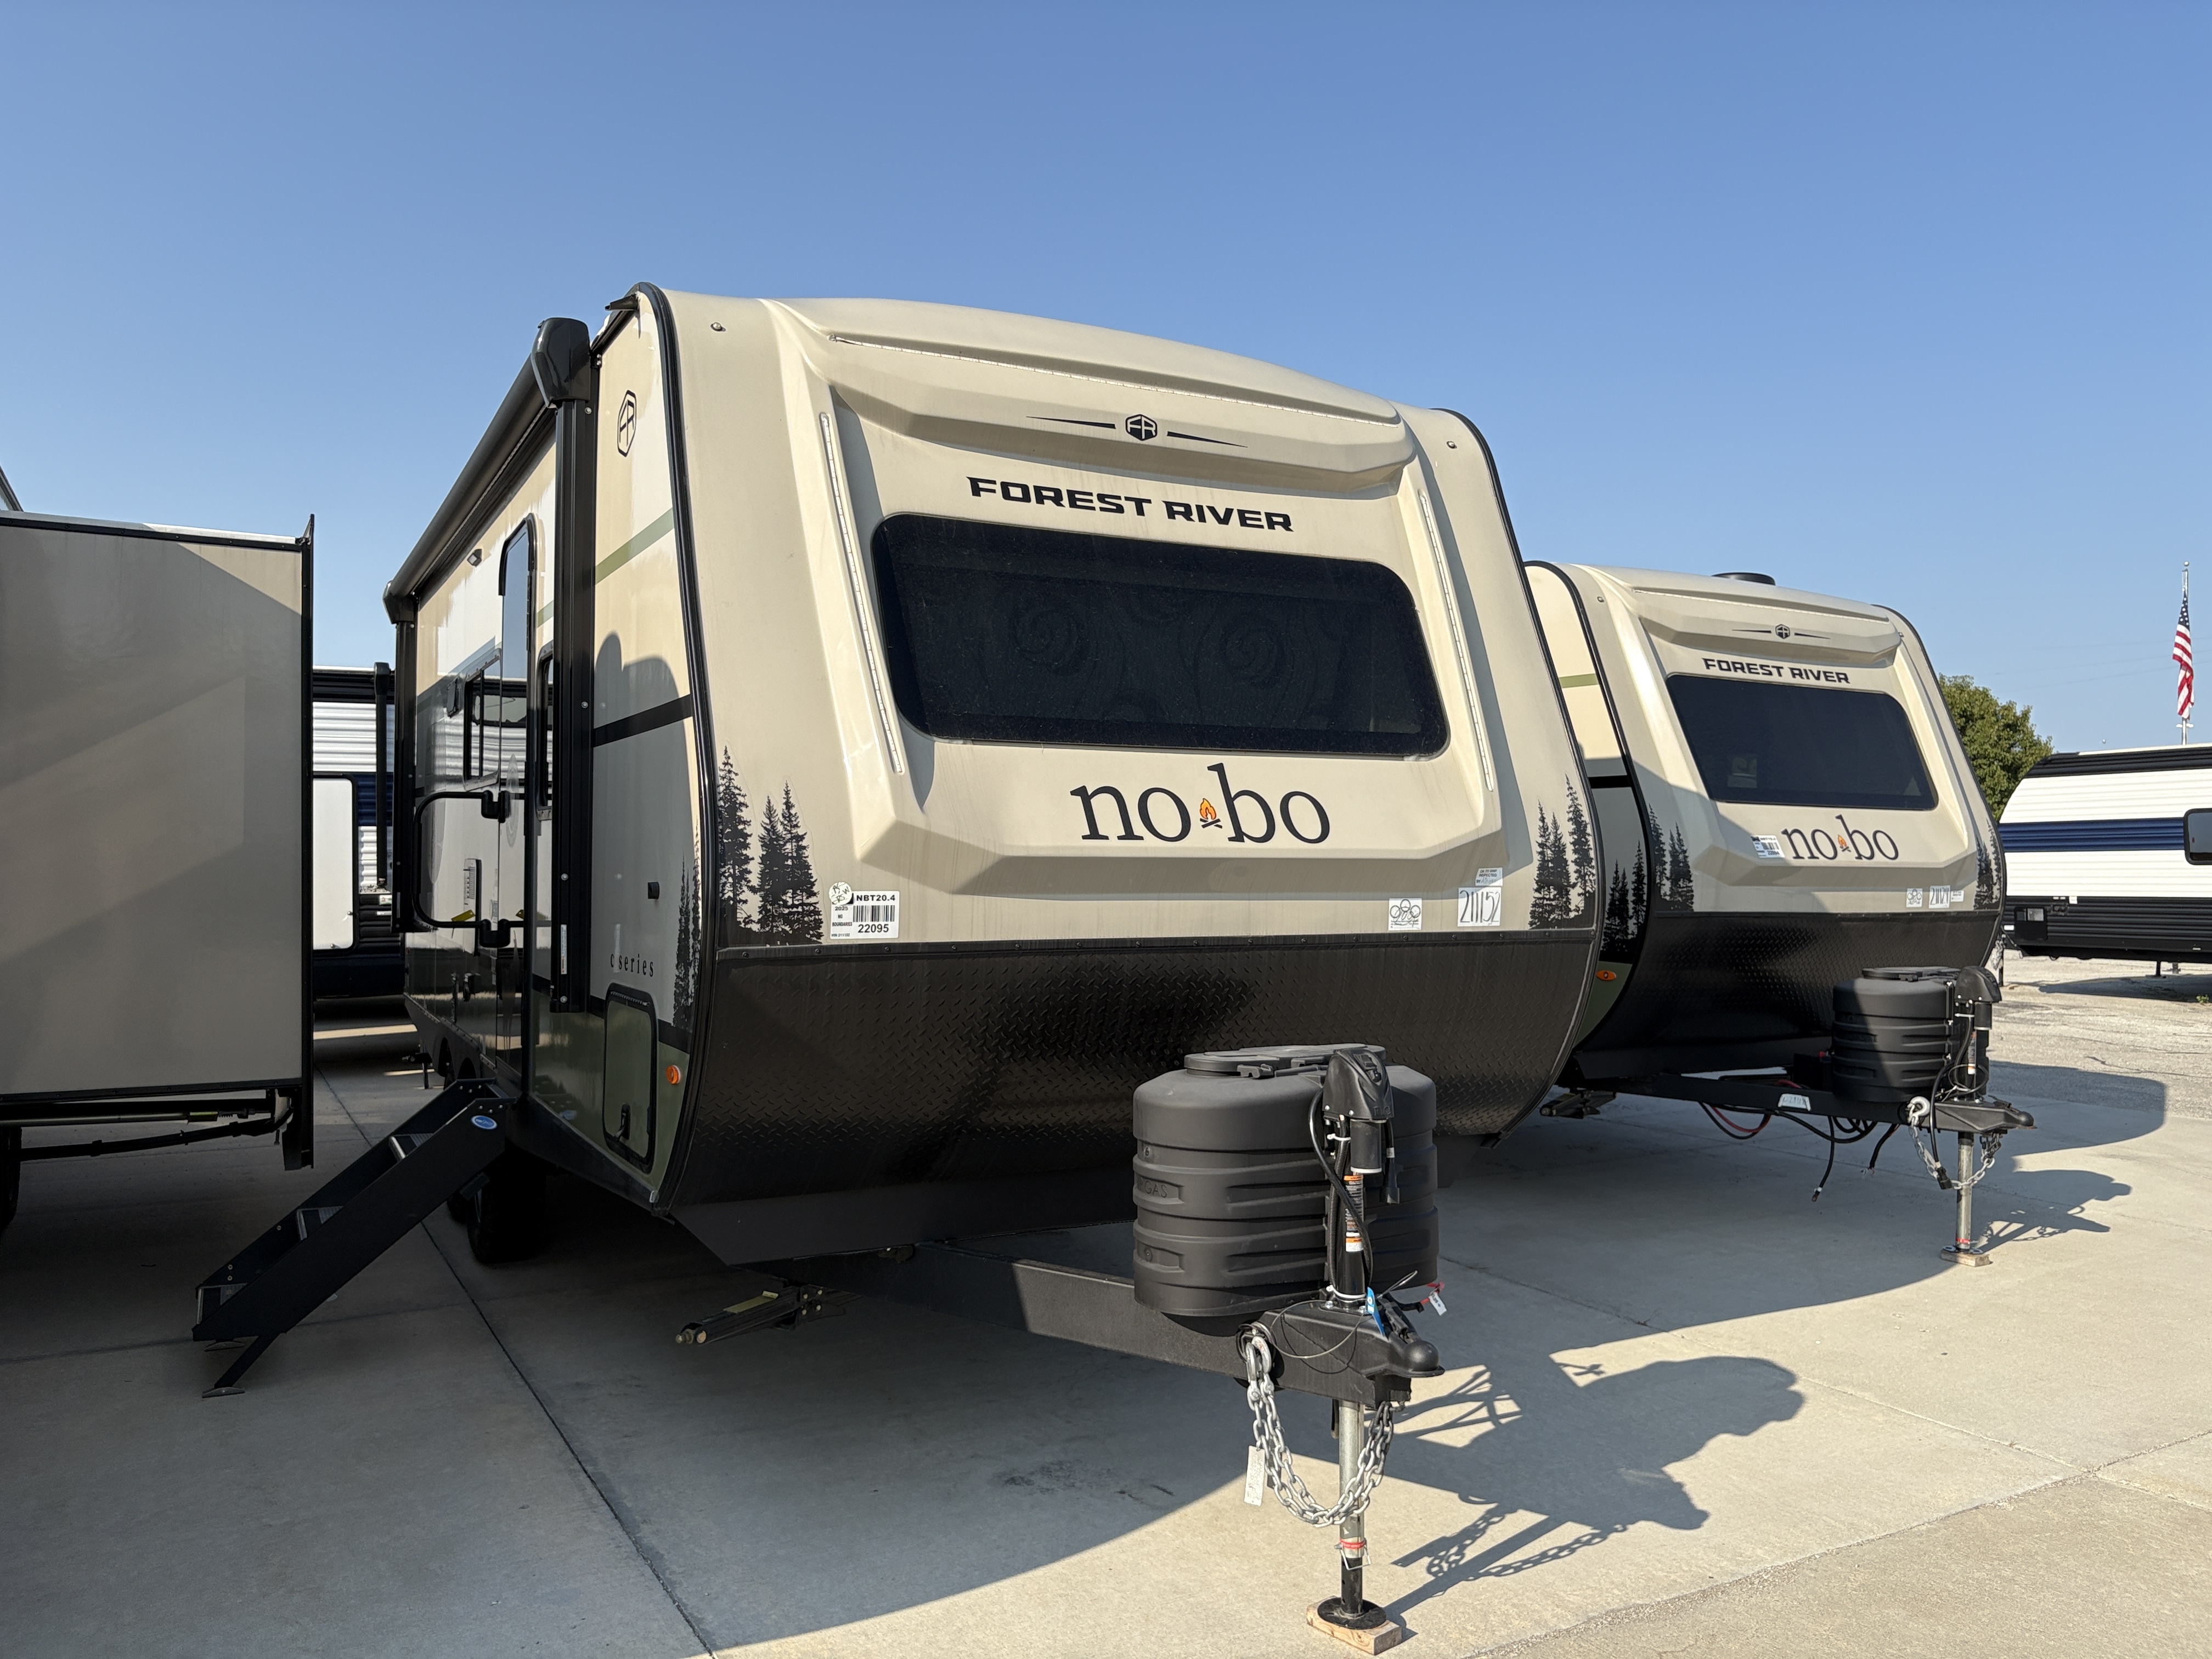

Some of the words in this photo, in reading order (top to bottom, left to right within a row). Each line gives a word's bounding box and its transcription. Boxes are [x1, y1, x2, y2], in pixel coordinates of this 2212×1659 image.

[966, 476, 1152, 516] FOREST
[1161, 500, 1294, 532] RIVER
[1701, 658, 1784, 677] FOREST
[1788, 667, 1851, 684] RIVER
[858, 924, 889, 933] 22095
[619, 953, 653, 977] series
[1145, 1180, 1167, 1198] GAS
